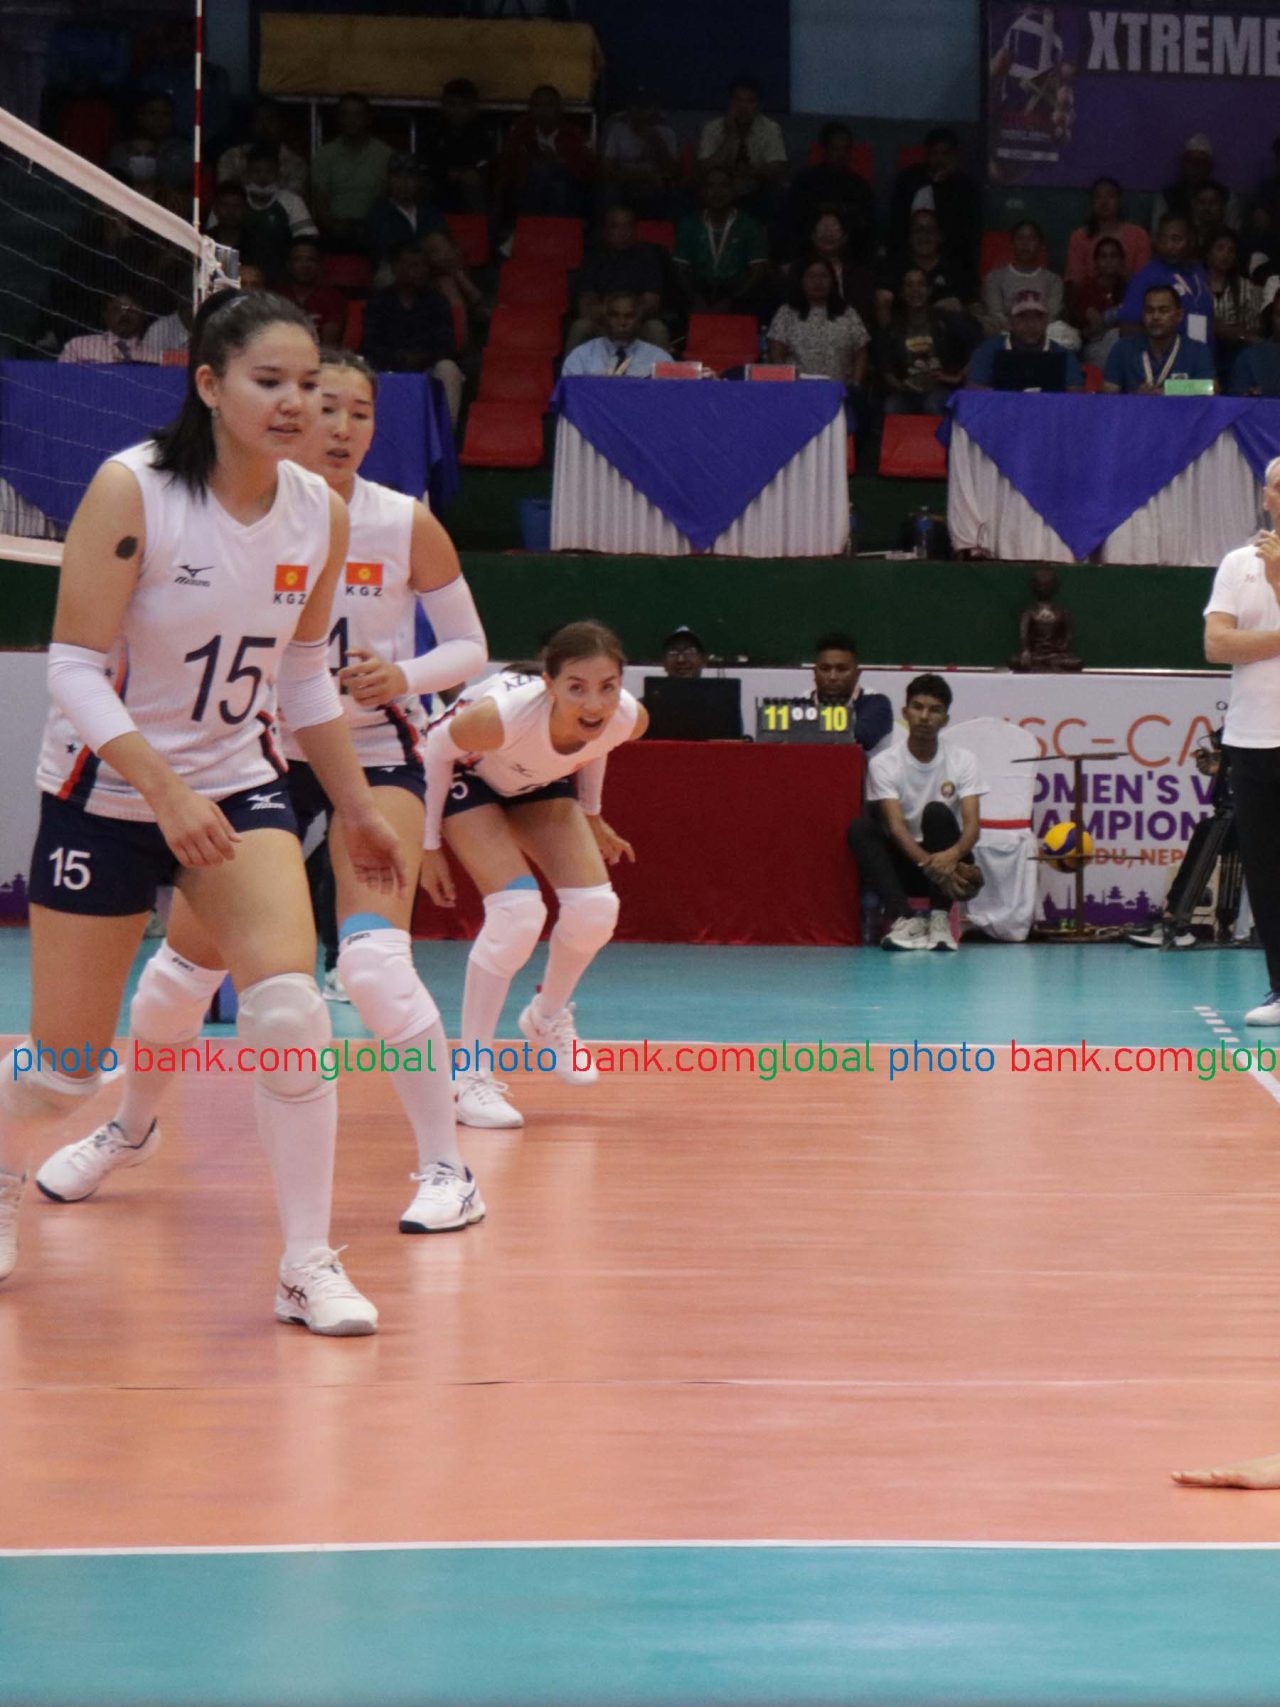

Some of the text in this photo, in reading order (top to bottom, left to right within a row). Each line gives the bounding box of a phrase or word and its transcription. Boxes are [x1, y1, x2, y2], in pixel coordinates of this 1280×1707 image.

[273, 593, 307, 605] KGZ
[345, 586, 383, 597] KGZ
[184, 634, 277, 725] 15
[764, 705, 789, 731] 11
[821, 706, 848, 732] 10
[1033, 771, 1180, 805] OMEN'S
[49, 847, 91, 890] 15
